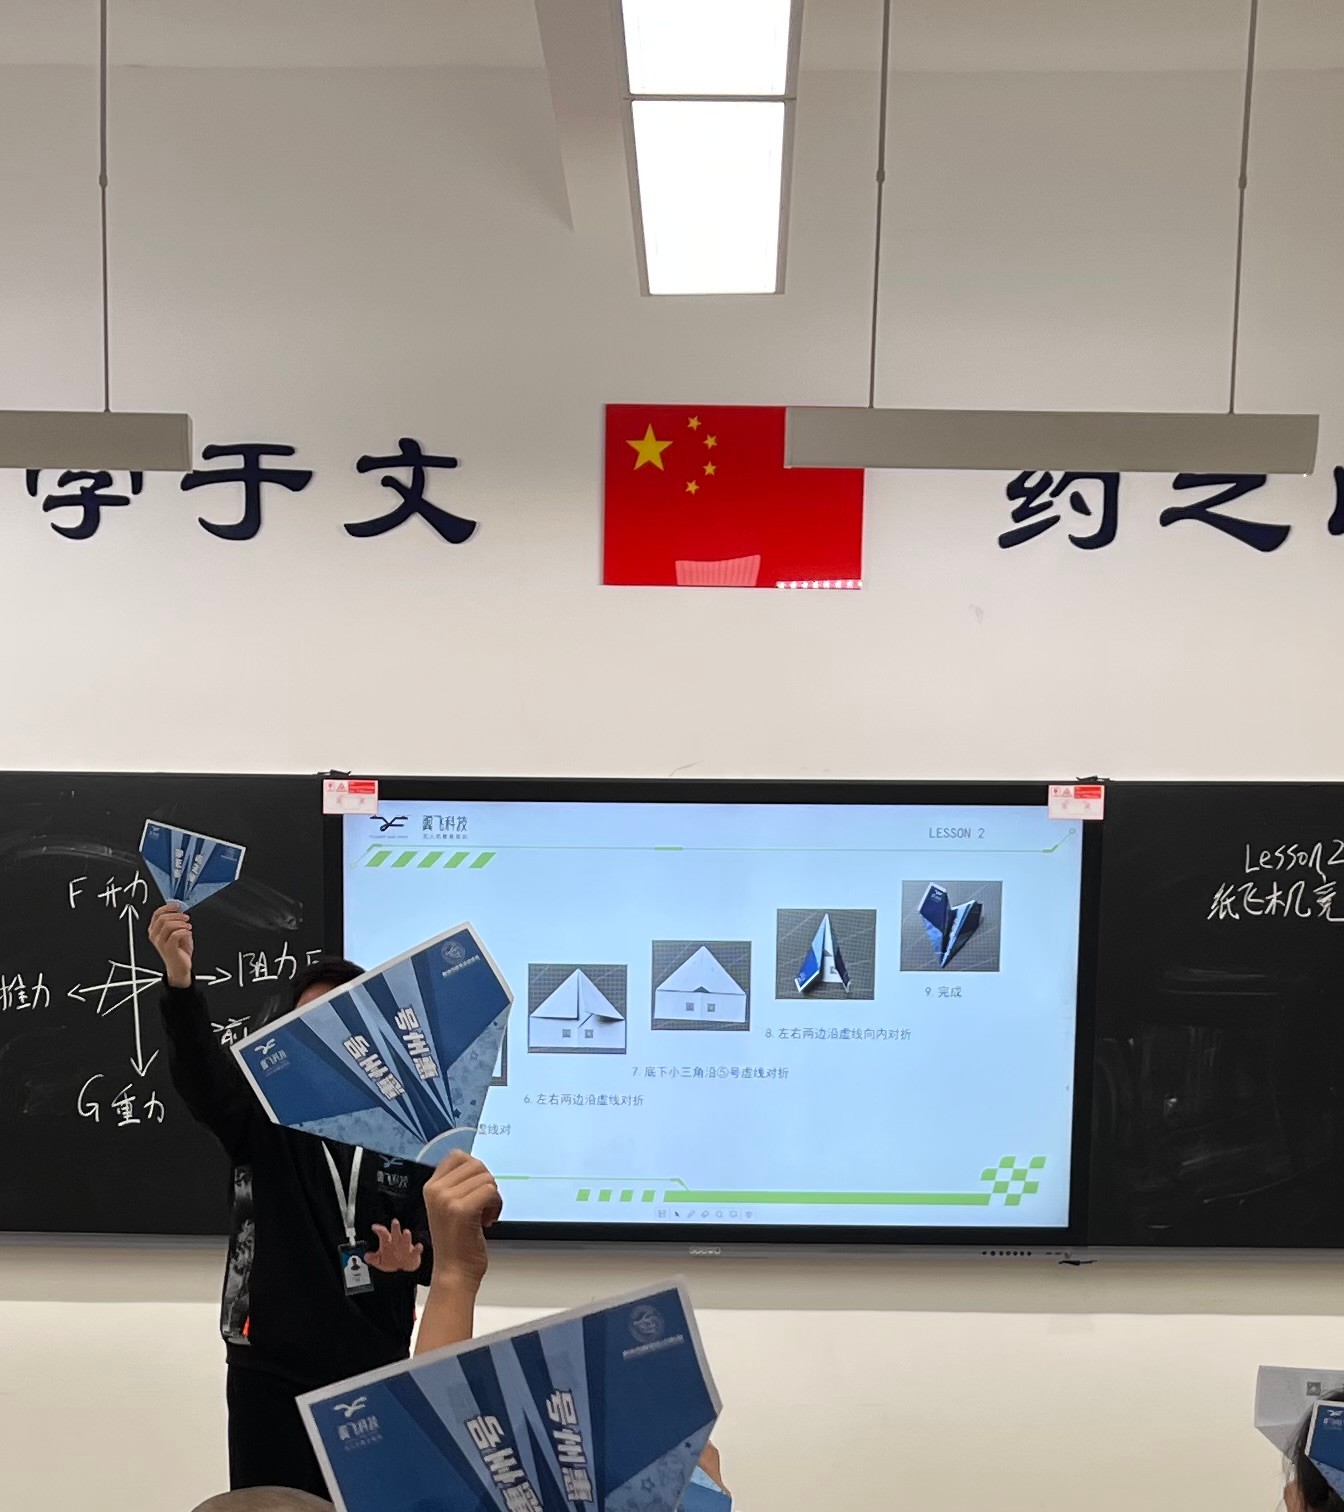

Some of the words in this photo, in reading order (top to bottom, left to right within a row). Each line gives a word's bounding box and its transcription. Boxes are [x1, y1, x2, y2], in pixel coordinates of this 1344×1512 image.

[929, 827, 971, 839] LESSON
[978, 827, 985, 839] 2
[1245, 842, 1327, 883] Lesson
[69, 876, 87, 908] F
[238, 941, 297, 987] 阻力
[938, 986, 962, 998] 完成
[778, 1027, 912, 1041] 左右两边沿虚线向内对折
[77, 1073, 102, 1123] G
[111, 1083, 165, 1127] 重力
[536, 1093, 644, 1106] 左右两边沿虚线对折
